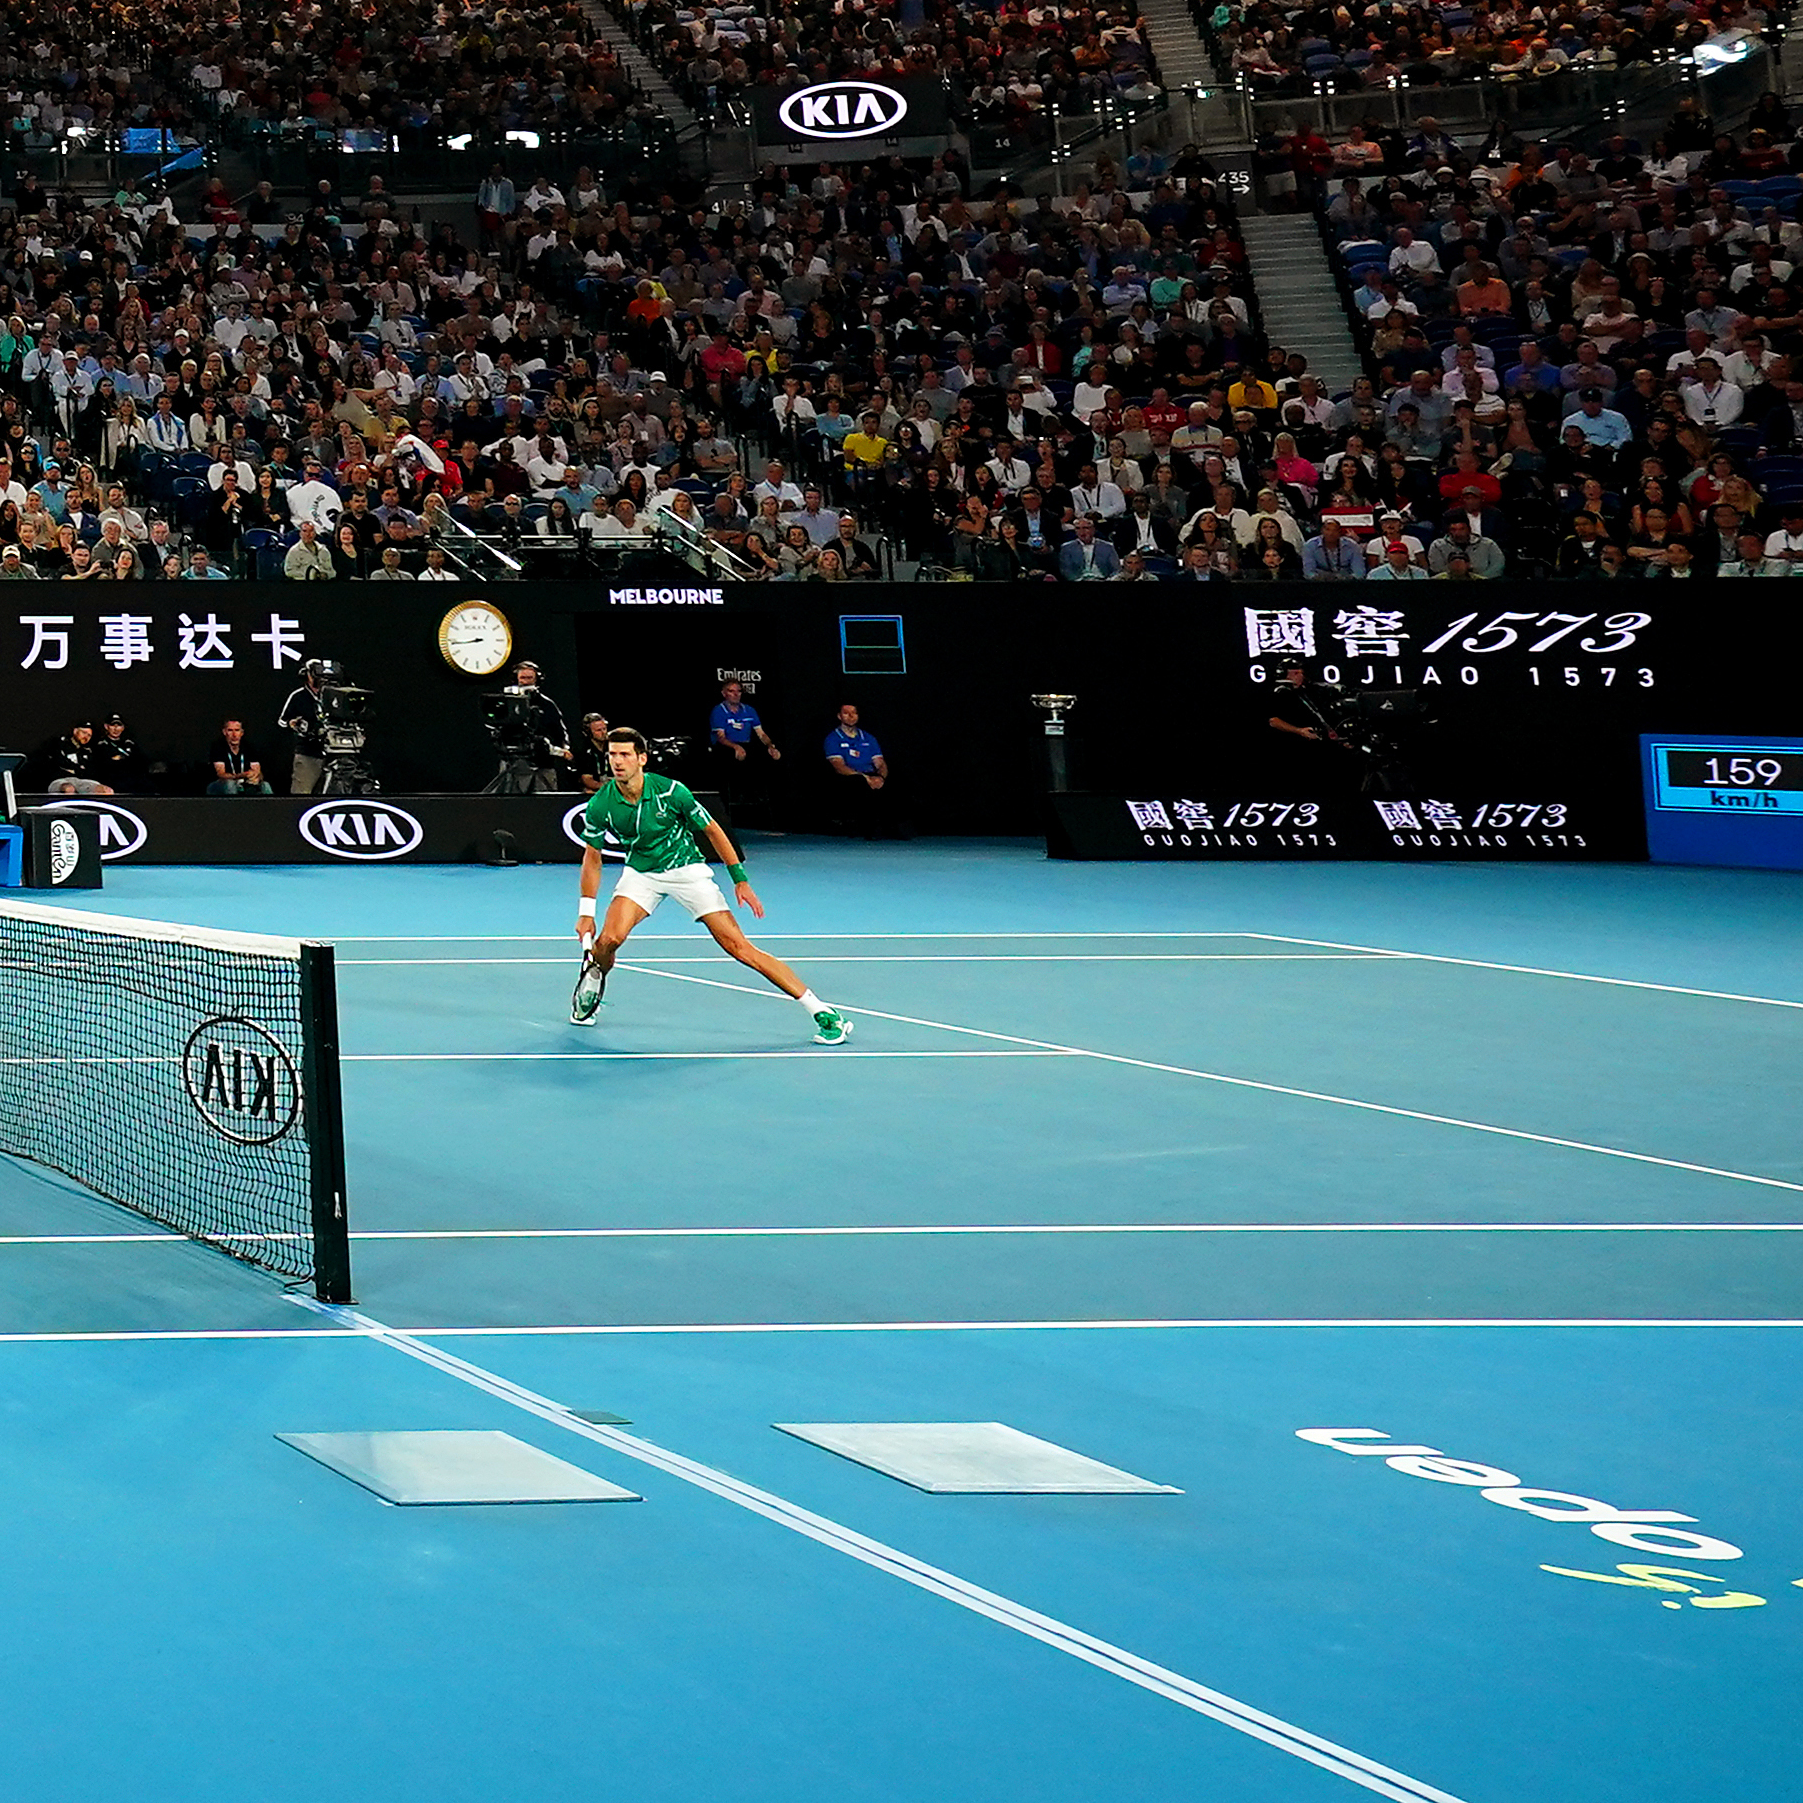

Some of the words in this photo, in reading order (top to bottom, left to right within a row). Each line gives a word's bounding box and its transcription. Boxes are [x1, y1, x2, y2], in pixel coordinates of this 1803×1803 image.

[801, 95, 887, 127] KIA
[995, 137, 1010, 148] 14
[1218, 171, 1250, 185] 435
[609, 588, 724, 605] MELBOURNE
[20, 613, 307, 670] 万事达卡
[1422, 611, 1652, 653] 1573
[716, 667, 762, 682] Emirates
[1249, 664, 1480, 687] GOJIAO
[1528, 666, 1656, 688] 1573
[1703, 757, 1782, 786] 159
[1710, 790, 1779, 808] km/h
[1223, 802, 1320, 828] 1573
[1471, 802, 1568, 828] 1573
[316, 813, 407, 846] KIA
[1143, 834, 1258, 847] GUOJIAO
[1276, 834, 1337, 847] 1573
[1392, 834, 1508, 847] GUOJIAO
[1525, 834, 1587, 847] 1573
[1295, 1427, 1744, 1560] open
